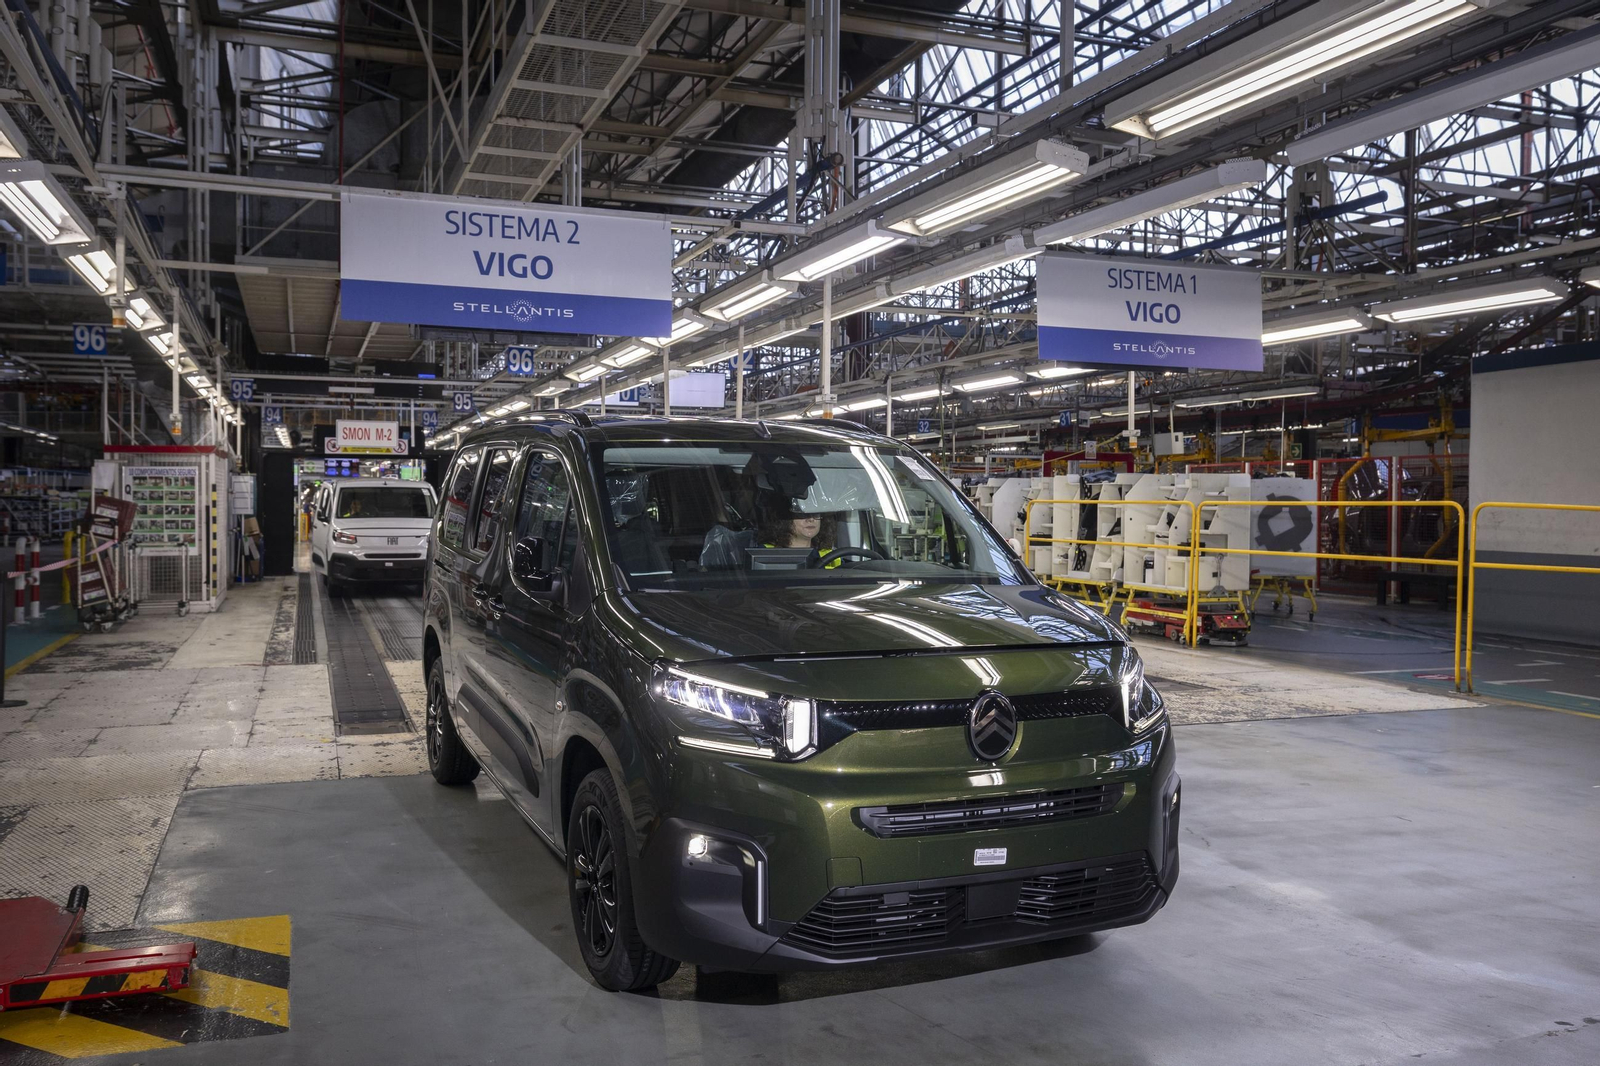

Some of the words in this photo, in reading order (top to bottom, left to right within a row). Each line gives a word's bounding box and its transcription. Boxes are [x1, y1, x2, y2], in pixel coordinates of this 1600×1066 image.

[445, 210, 561, 243] SISTEMA
[567, 220, 580, 245] 2
[472, 250, 554, 280] VIGO
[1107, 268, 1186, 294] SISTEMA
[1190, 274, 1197, 295] 1
[453, 301, 574, 319] STELLANTIS
[1125, 300, 1181, 324] VIGO
[75, 325, 106, 351] 96
[1113, 342, 1196, 356] STELLANTIS
[508, 349, 533, 373] 96
[231, 381, 253, 400] 95
[454, 393, 472, 410] 95
[266, 408, 281, 422] 94
[423, 412, 437, 425] 94
[1060, 411, 1071, 426] 31
[342, 426, 371, 440] SMON
[375, 428, 392, 441] M-2
[919, 420, 930, 432] 32
